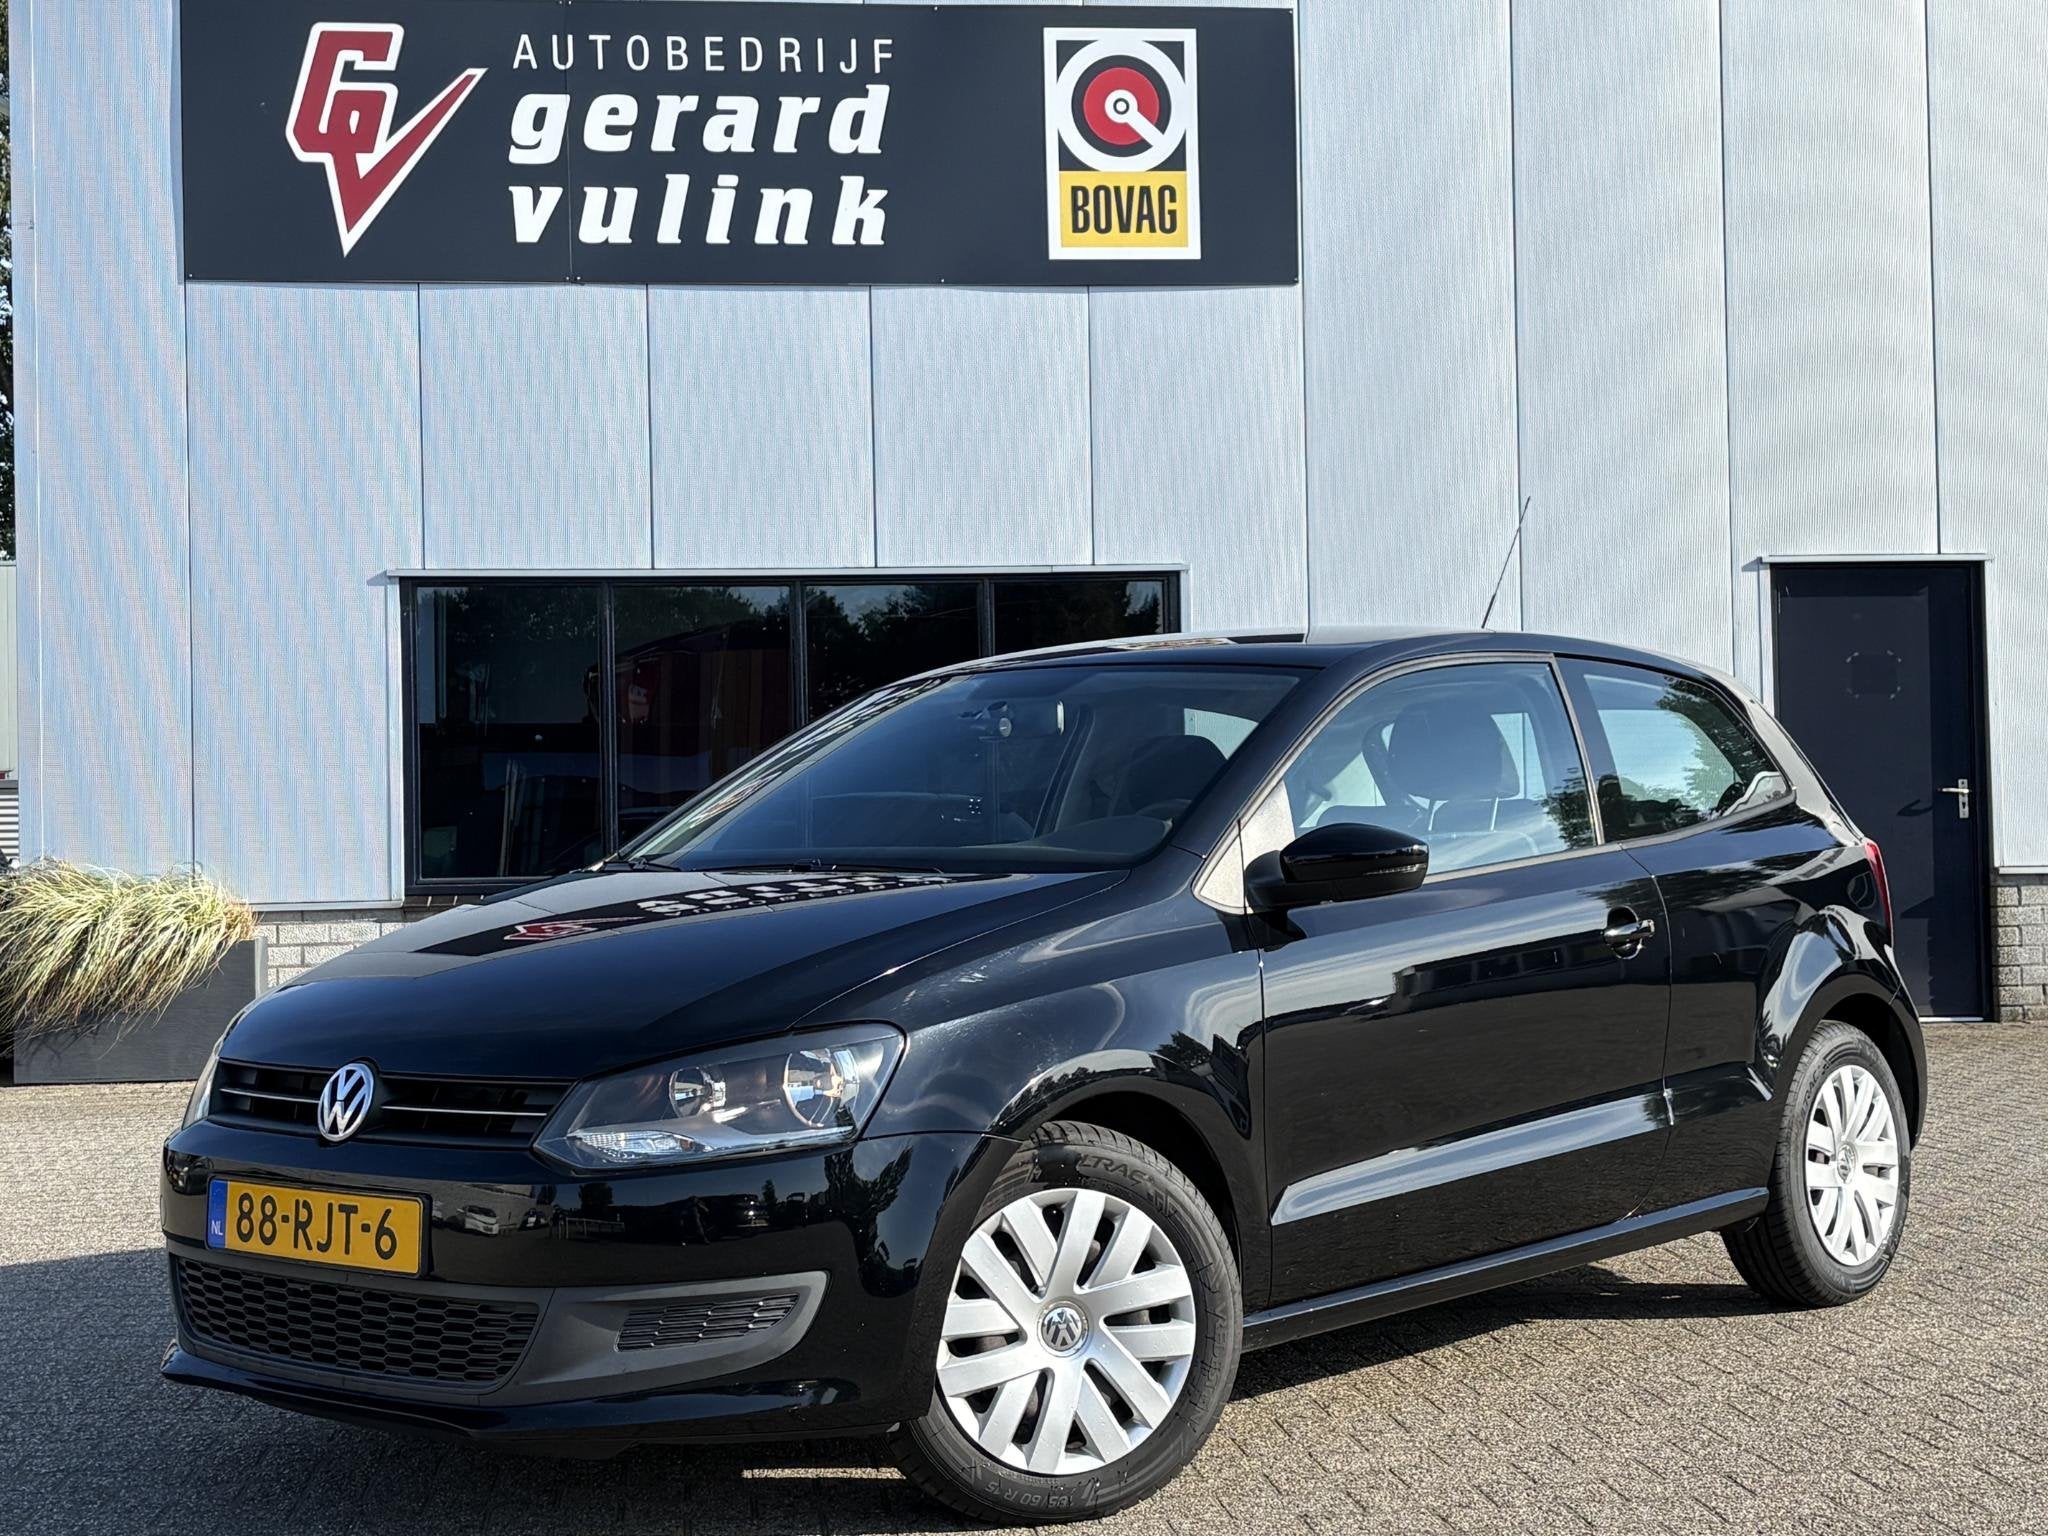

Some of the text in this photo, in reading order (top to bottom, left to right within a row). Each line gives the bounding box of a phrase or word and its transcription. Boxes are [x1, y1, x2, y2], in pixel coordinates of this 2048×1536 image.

[512, 33, 893, 74] AUTOBEDRIJF
[508, 84, 891, 165] gerard
[507, 173, 889, 246] vulink
[1070, 184, 1178, 234] BOVAG
[210, 1220, 224, 1236] NL
[235, 1192, 398, 1261] 88-RJT-6
